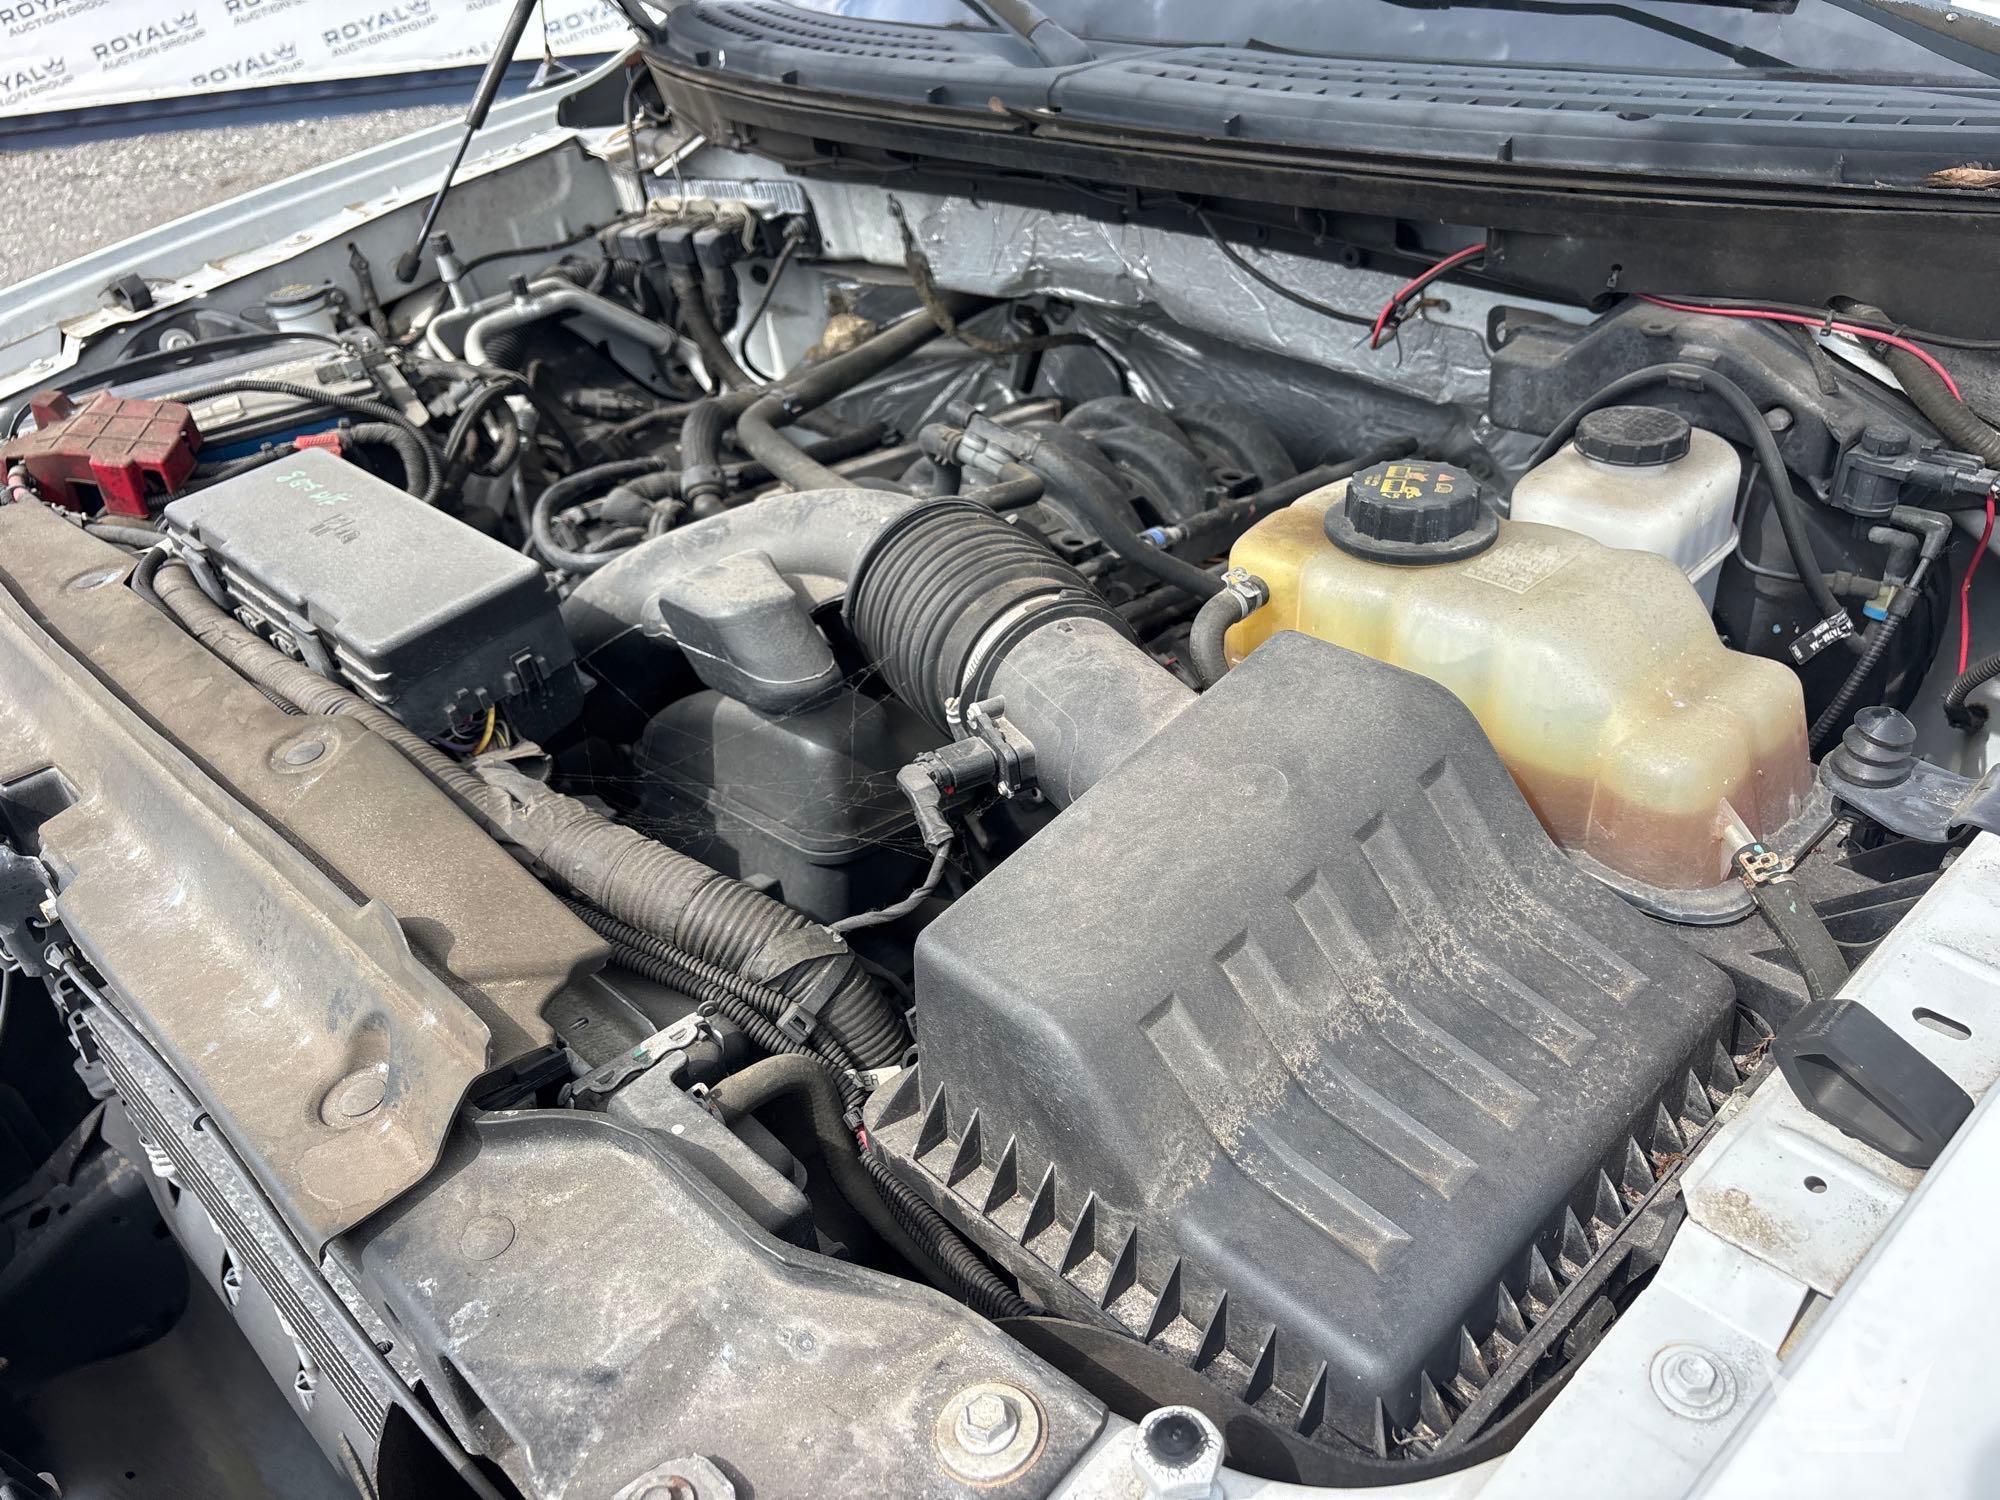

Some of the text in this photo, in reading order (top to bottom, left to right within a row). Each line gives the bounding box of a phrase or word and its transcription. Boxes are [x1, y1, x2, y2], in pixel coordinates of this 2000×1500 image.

[9, 0, 109, 38] AUCTION GROU
[321, 6, 411, 47] ROYAL
[92, 20, 176, 61] ROYAL
[102, 28, 206, 72] AUCTION GROUP
[331, 31, 388, 58] AUCTION
[29, 74, 74, 95] GROUP
